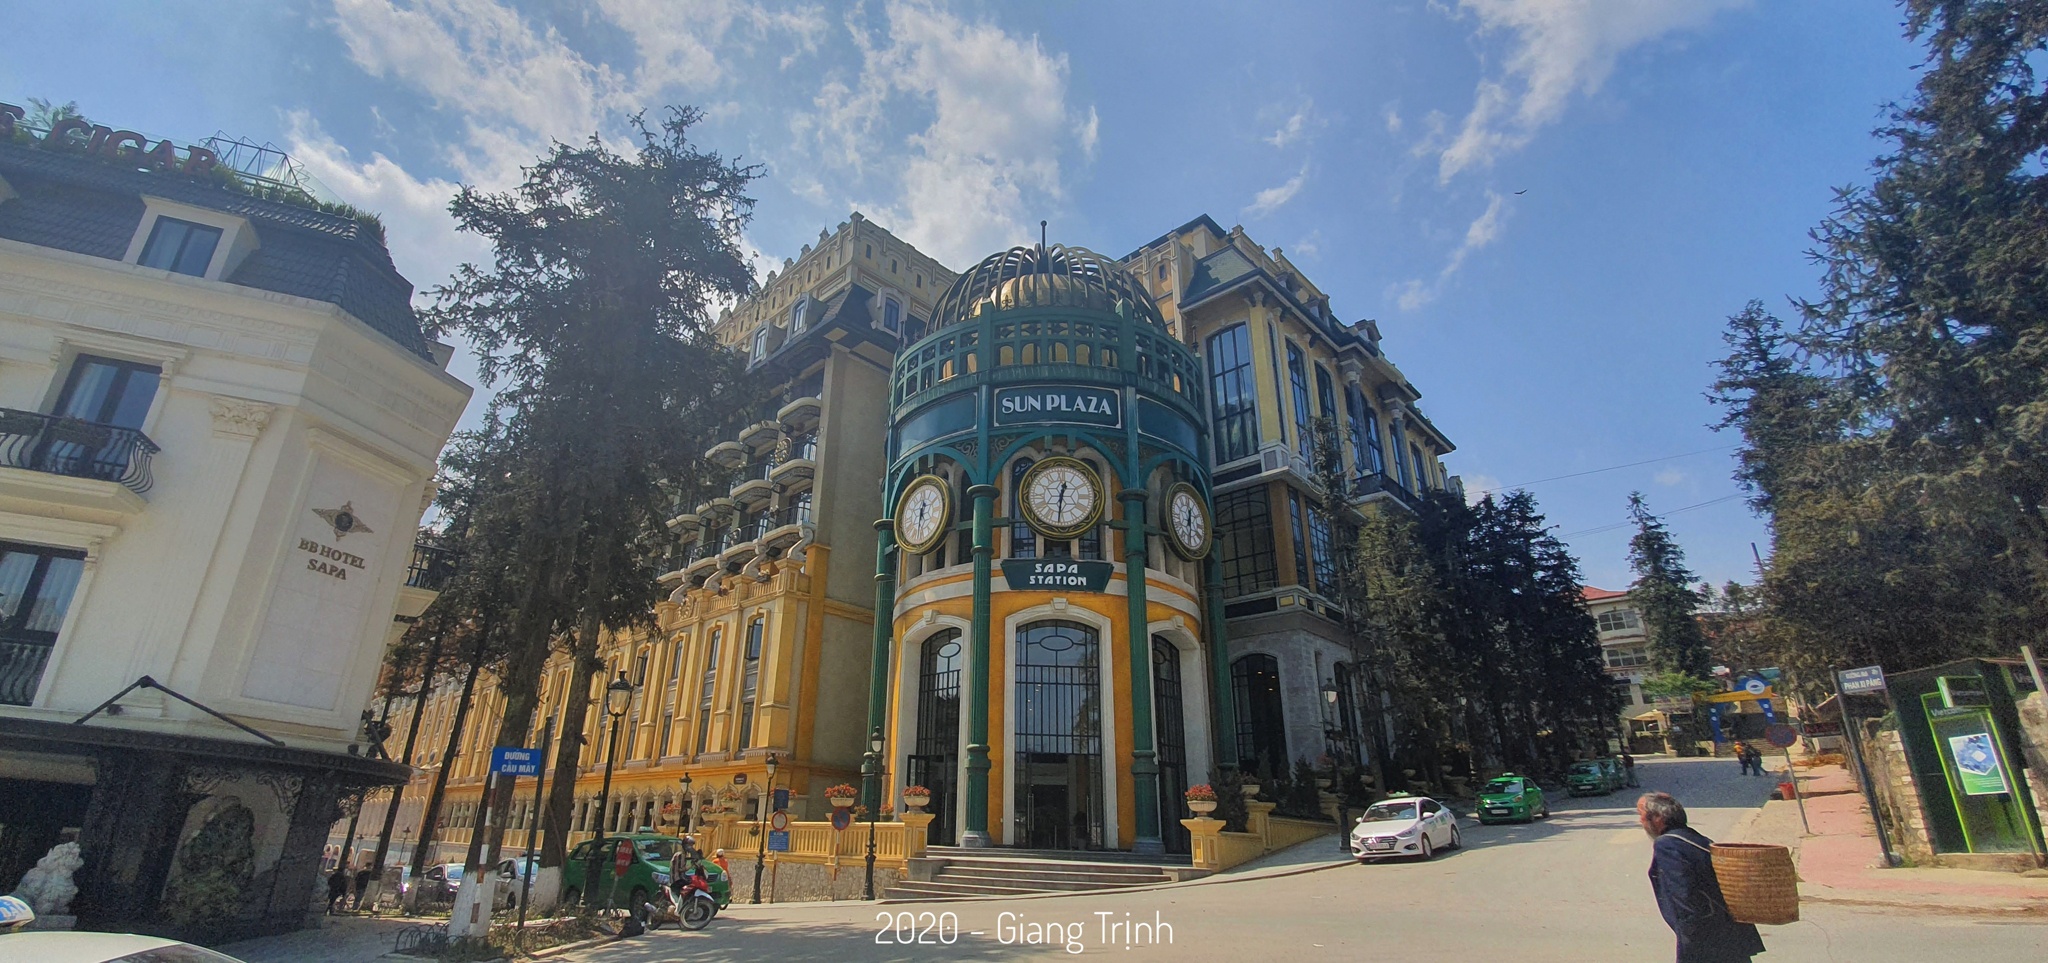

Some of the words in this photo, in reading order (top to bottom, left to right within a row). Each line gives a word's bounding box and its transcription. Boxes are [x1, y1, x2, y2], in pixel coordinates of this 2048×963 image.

[46, 117, 218, 176] CIGAR
[1002, 394, 1041, 414] SUN
[1046, 394, 1112, 415] PLAZA
[298, 537, 319, 554] BB
[319, 544, 366, 570] HOTEL
[307, 558, 346, 580] SAPA
[1035, 563, 1078, 574] SAPA
[1029, 575, 1087, 586] STATION
